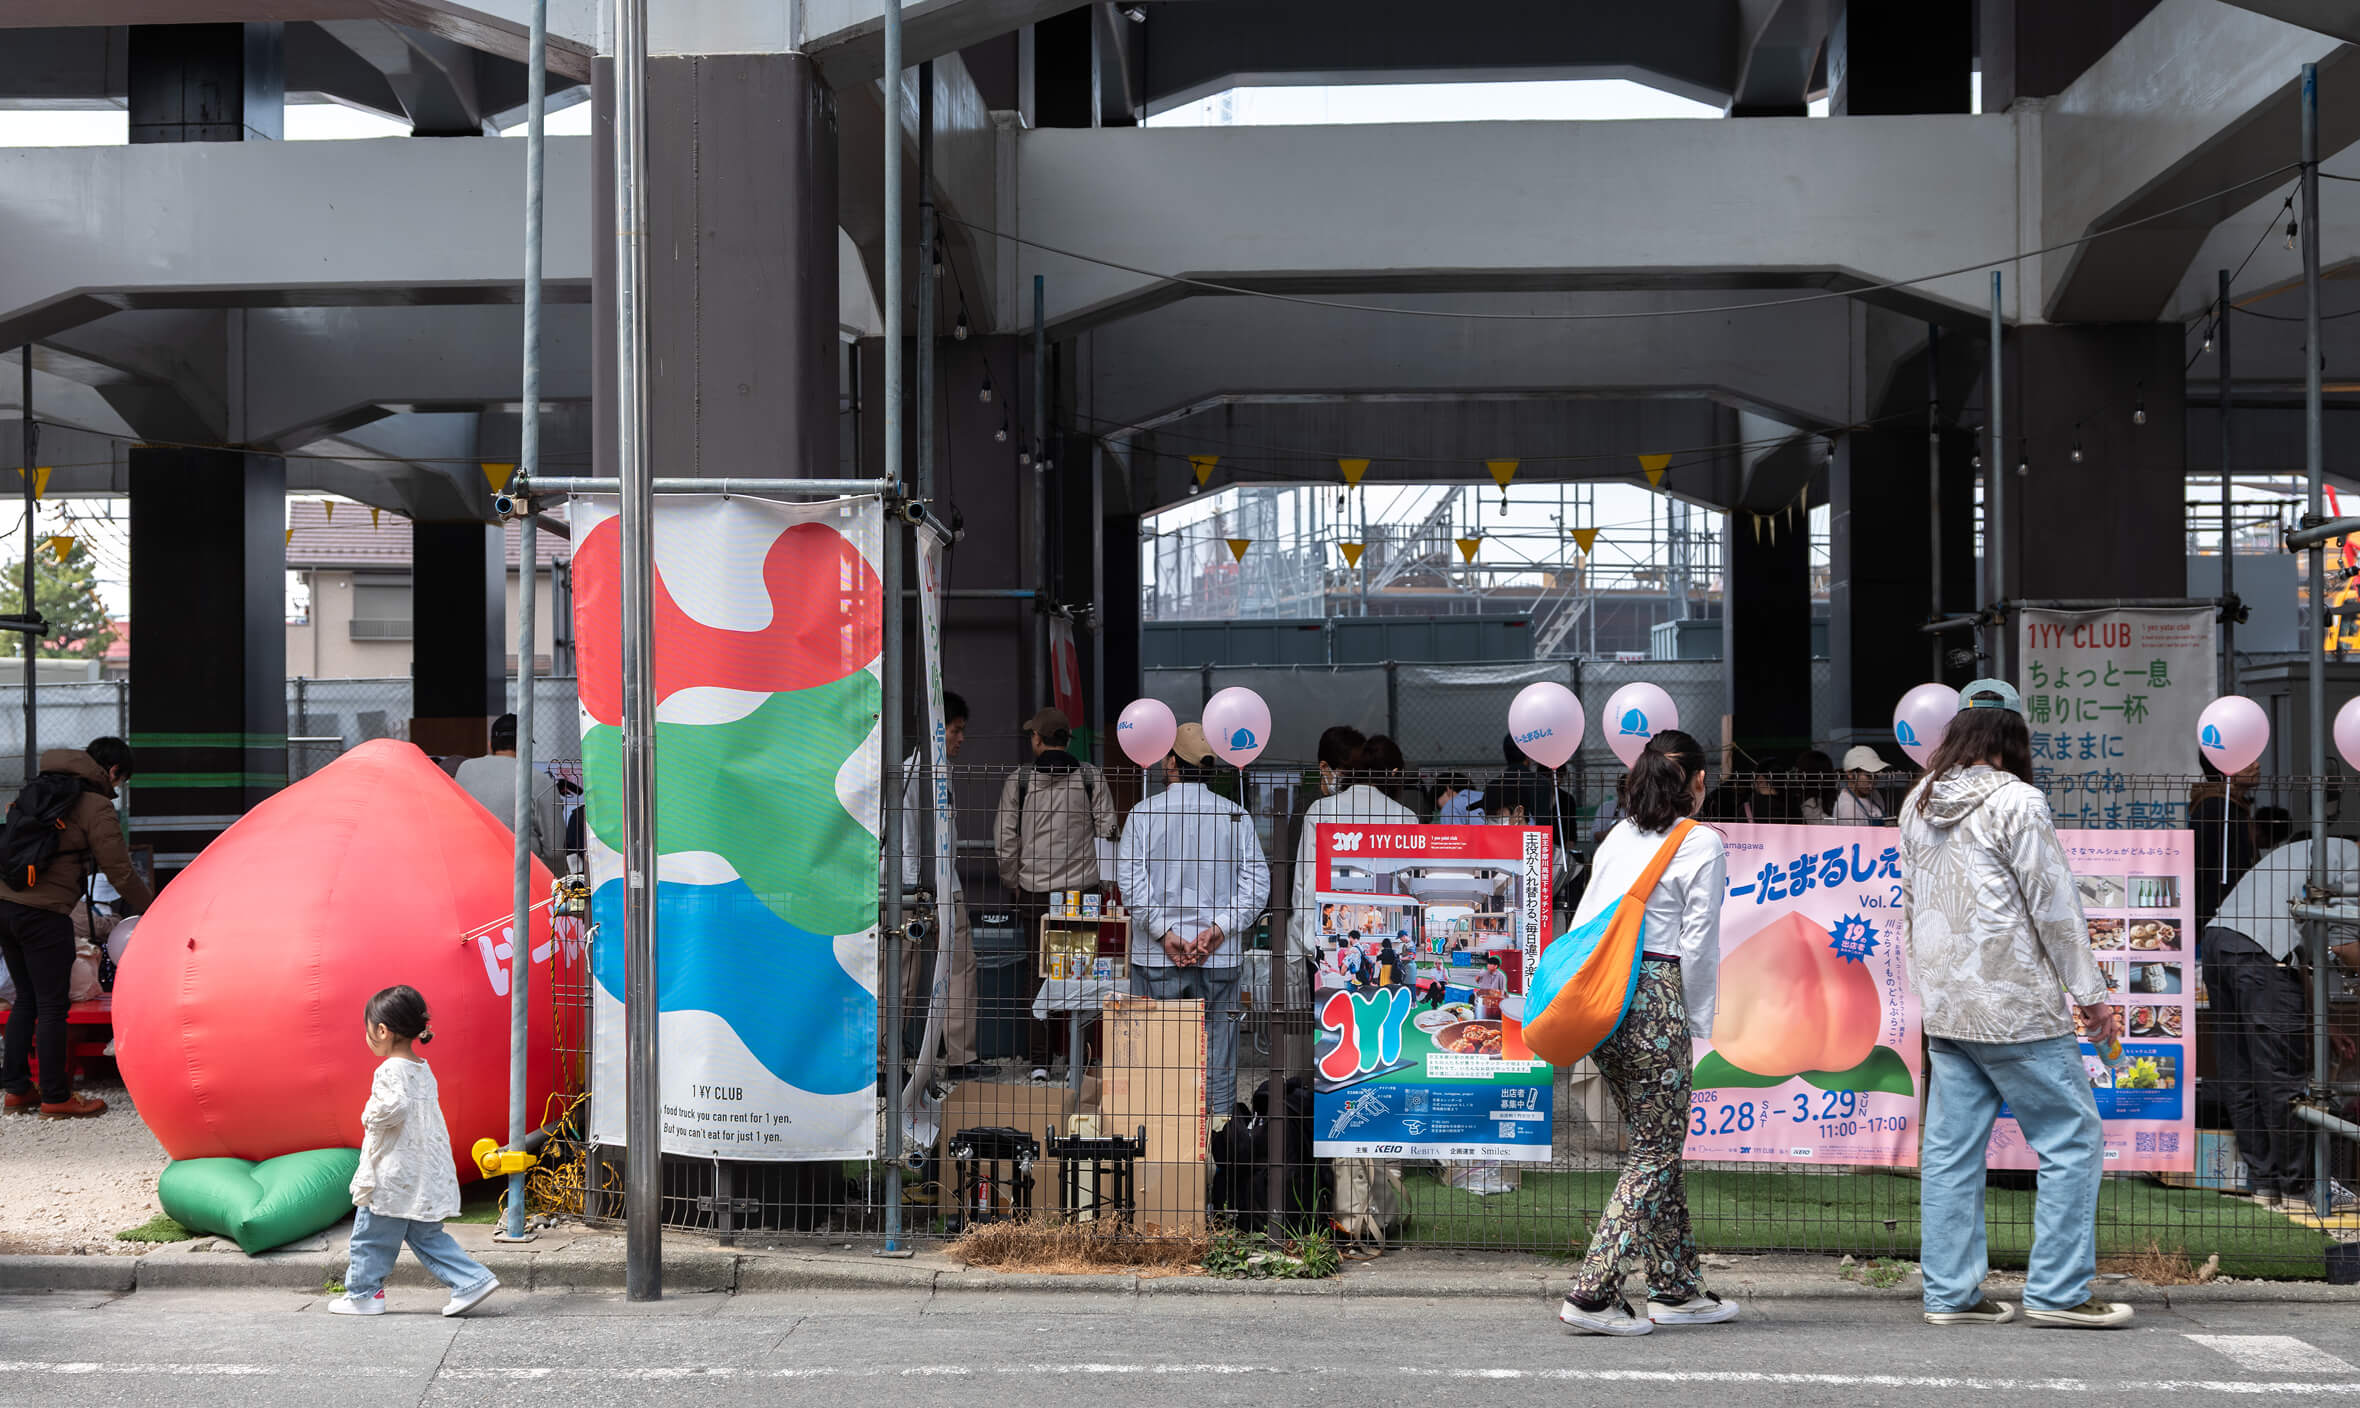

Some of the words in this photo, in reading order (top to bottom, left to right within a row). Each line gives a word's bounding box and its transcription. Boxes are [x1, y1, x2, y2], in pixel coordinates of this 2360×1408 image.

[2028, 624, 2065, 648] 1YY
[2074, 623, 2132, 648] CLUB
[2028, 658, 2172, 688] ちょっと一息
[2027, 694, 2149, 724] 帰りに一杯
[2031, 731, 2124, 760] 気ままに
[1369, 834, 1392, 849] 1YY
[1395, 834, 1426, 849] CLUB
[1859, 894, 1886, 909] Vol.
[1890, 885, 1903, 908] 2
[692, 1084, 696, 1098] 1
[714, 1086, 743, 1101] CLUB
[1501, 1088, 1524, 1098] 出店者
[1690, 1091, 1718, 1104] 2026
[664, 1104, 678, 1116] food
[679, 1106, 695, 1118] truck
[697, 1112, 710, 1122] you
[713, 1113, 727, 1122] can
[730, 1113, 747, 1123] rent
[750, 1112, 763, 1123] for
[766, 1113, 770, 1123] 1
[773, 1114, 792, 1125] yen.
[1690, 1102, 1755, 1136] 3.28
[1760, 1100, 1769, 1128] SAT
[1792, 1089, 1856, 1123] 3.29
[1858, 1090, 1870, 1116] SUN
[664, 1122, 674, 1133] But
[676, 1127, 687, 1136] you
[688, 1128, 705, 1138] can't
[708, 1130, 720, 1140] eat
[723, 1130, 735, 1140] for
[736, 1130, 753, 1143] just
[756, 1131, 760, 1141] 1
[763, 1133, 783, 1144] yen.
[1374, 1145, 1403, 1153] KEIO
